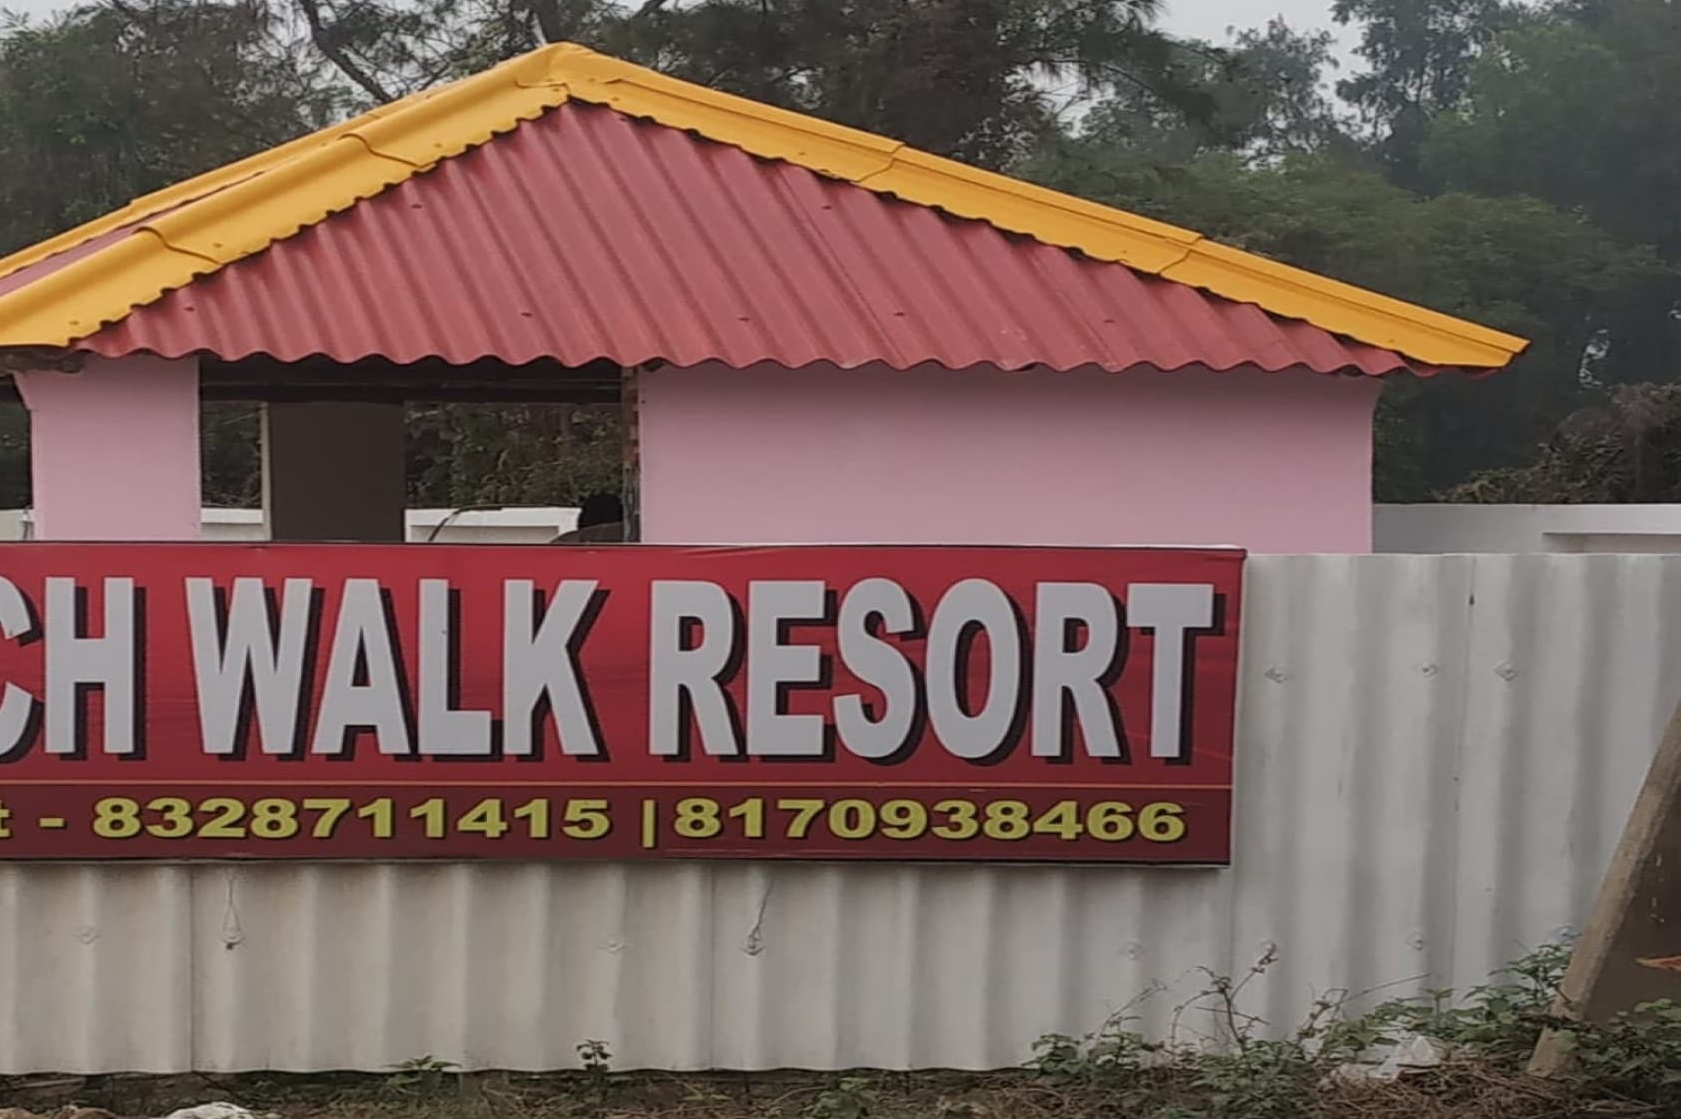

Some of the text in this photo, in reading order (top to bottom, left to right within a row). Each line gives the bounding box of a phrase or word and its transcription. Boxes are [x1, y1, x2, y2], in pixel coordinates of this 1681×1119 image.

[185, 577, 600, 756] WALK
[649, 578, 1214, 759] RESORT
[92, 797, 611, 839] 8328711415
